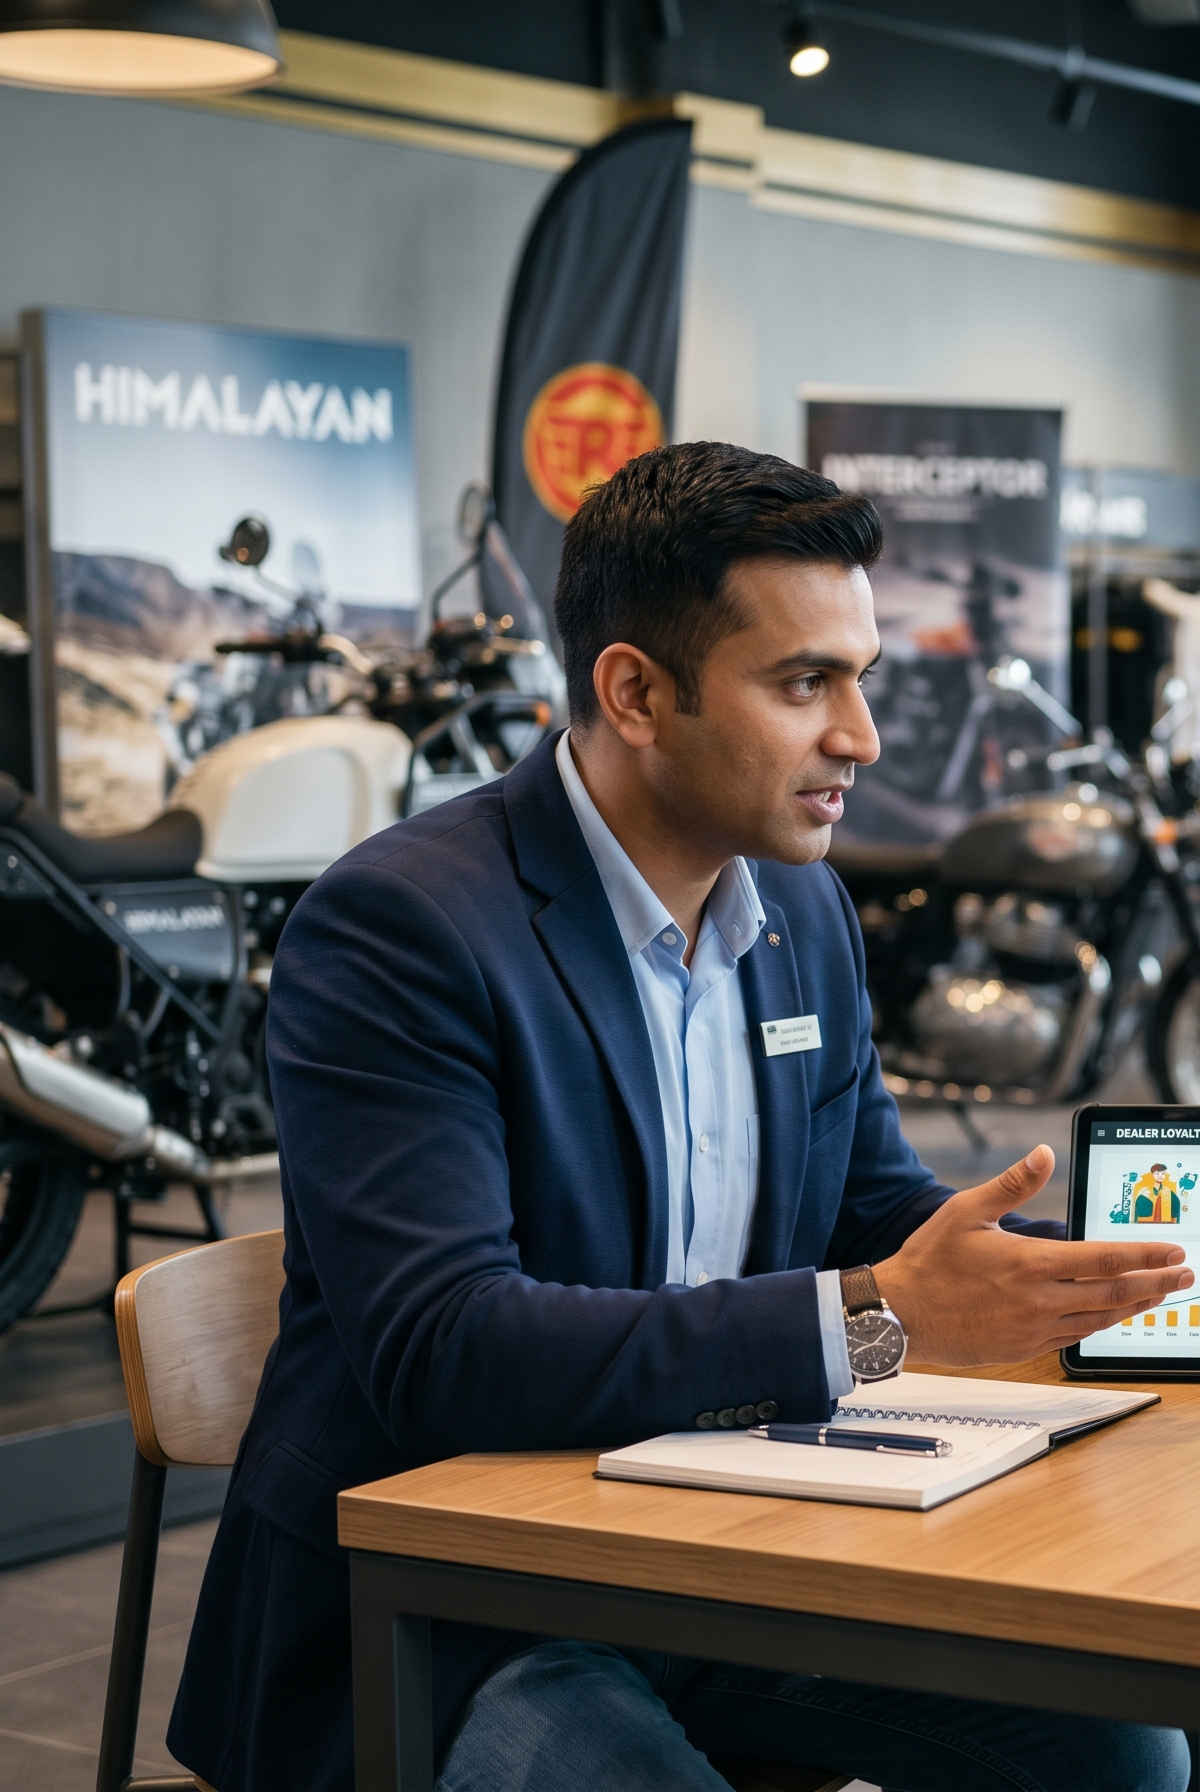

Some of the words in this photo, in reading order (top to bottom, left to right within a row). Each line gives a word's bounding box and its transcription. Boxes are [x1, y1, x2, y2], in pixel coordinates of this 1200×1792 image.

[74, 361, 394, 446] HIMALAYAN
[821, 453, 1049, 499] INTERCEPTOR
[1116, 1128, 1159, 1139] DEALER
